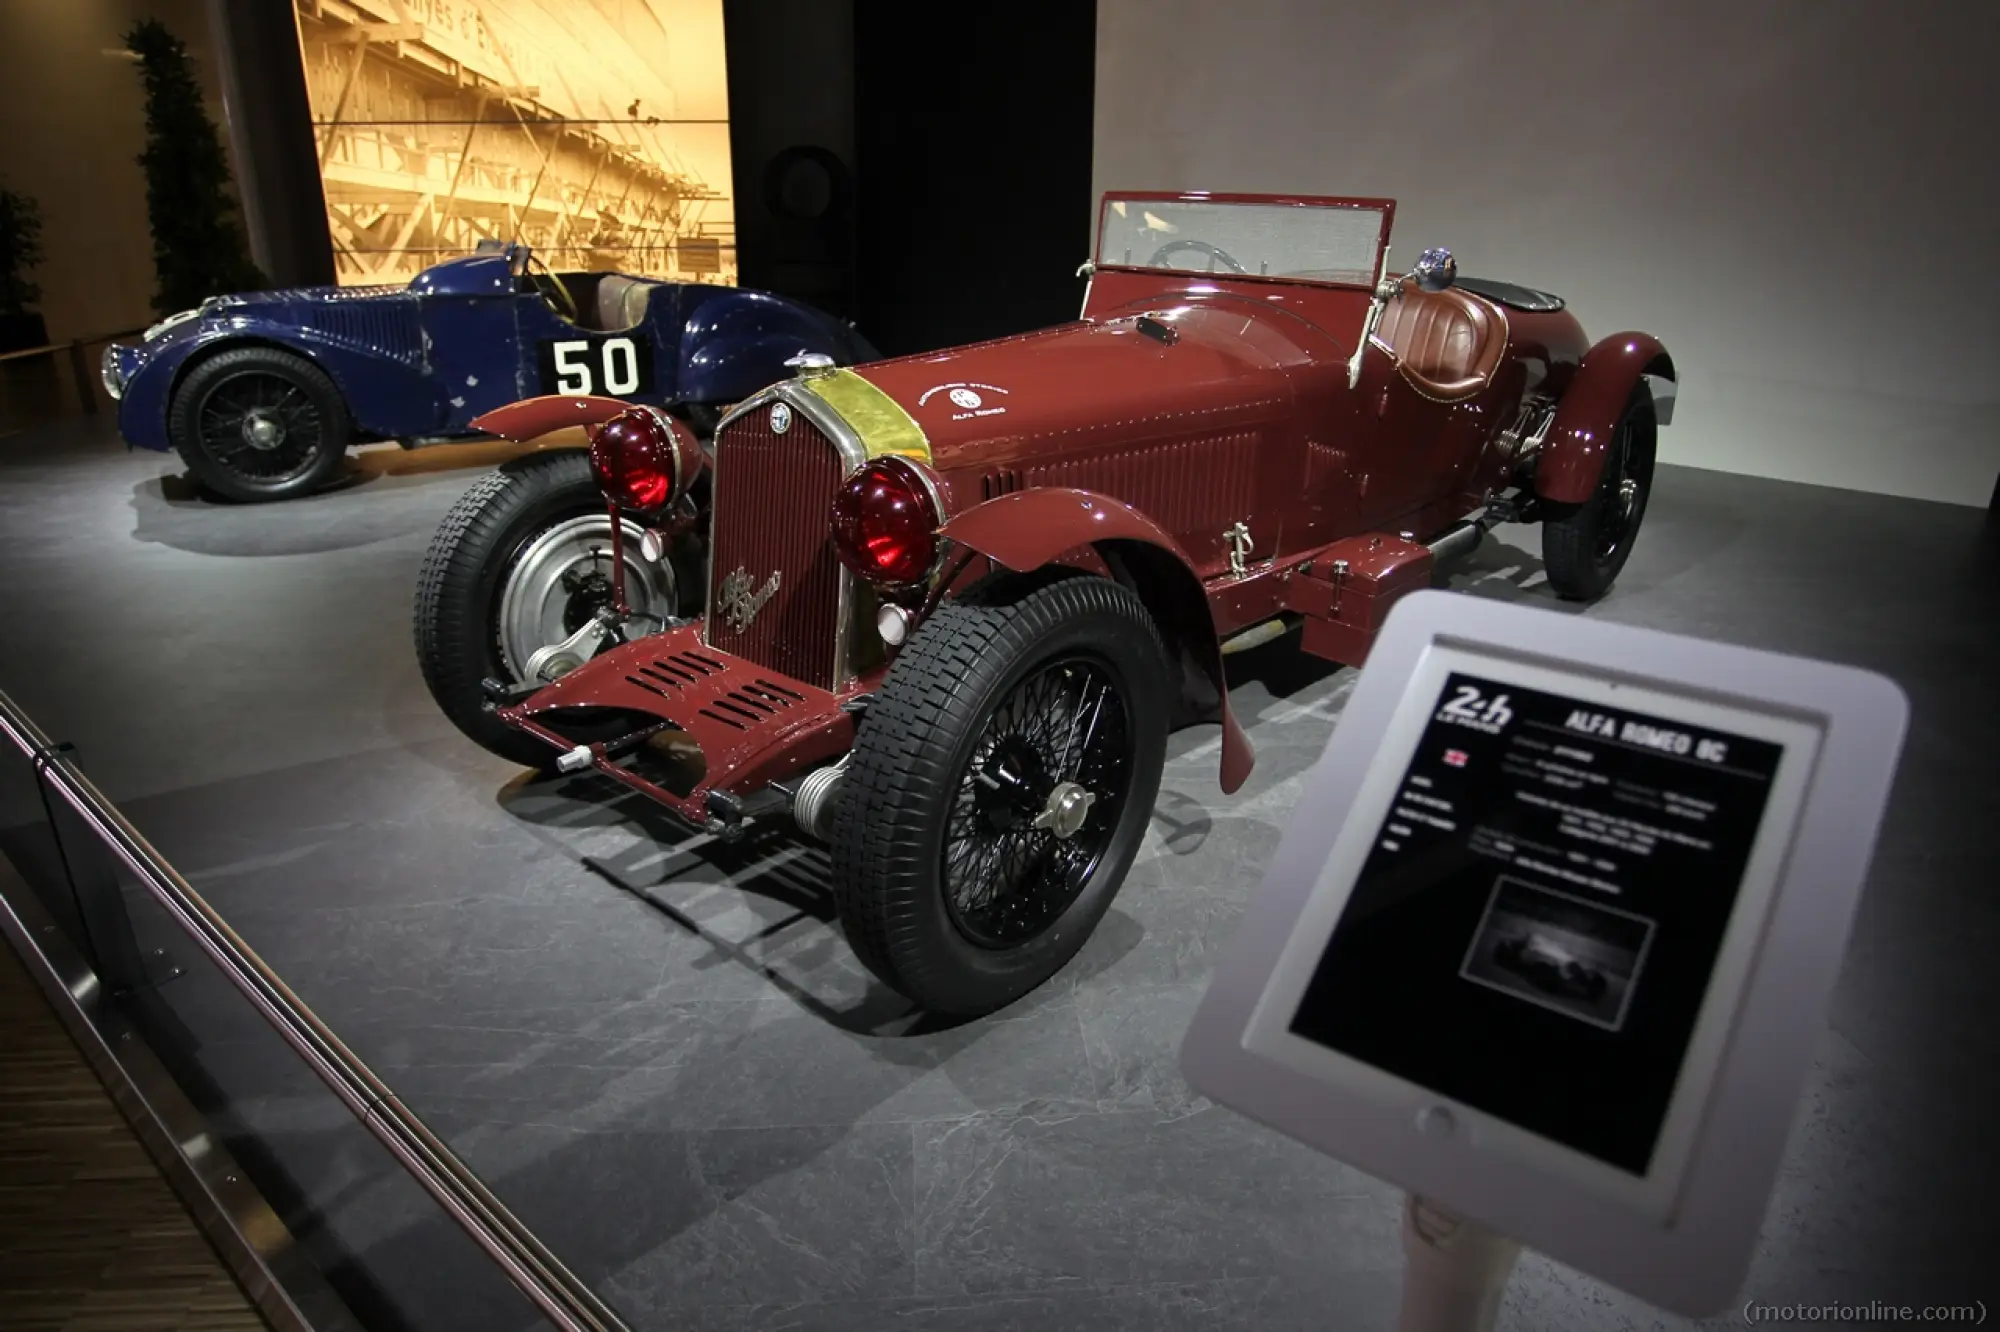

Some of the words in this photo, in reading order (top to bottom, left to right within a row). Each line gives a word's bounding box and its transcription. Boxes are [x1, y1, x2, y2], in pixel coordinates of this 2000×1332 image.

[553, 338, 640, 396] 50
[1565, 710, 1615, 737] ALFA
[1621, 722, 1691, 754] ROMEO
